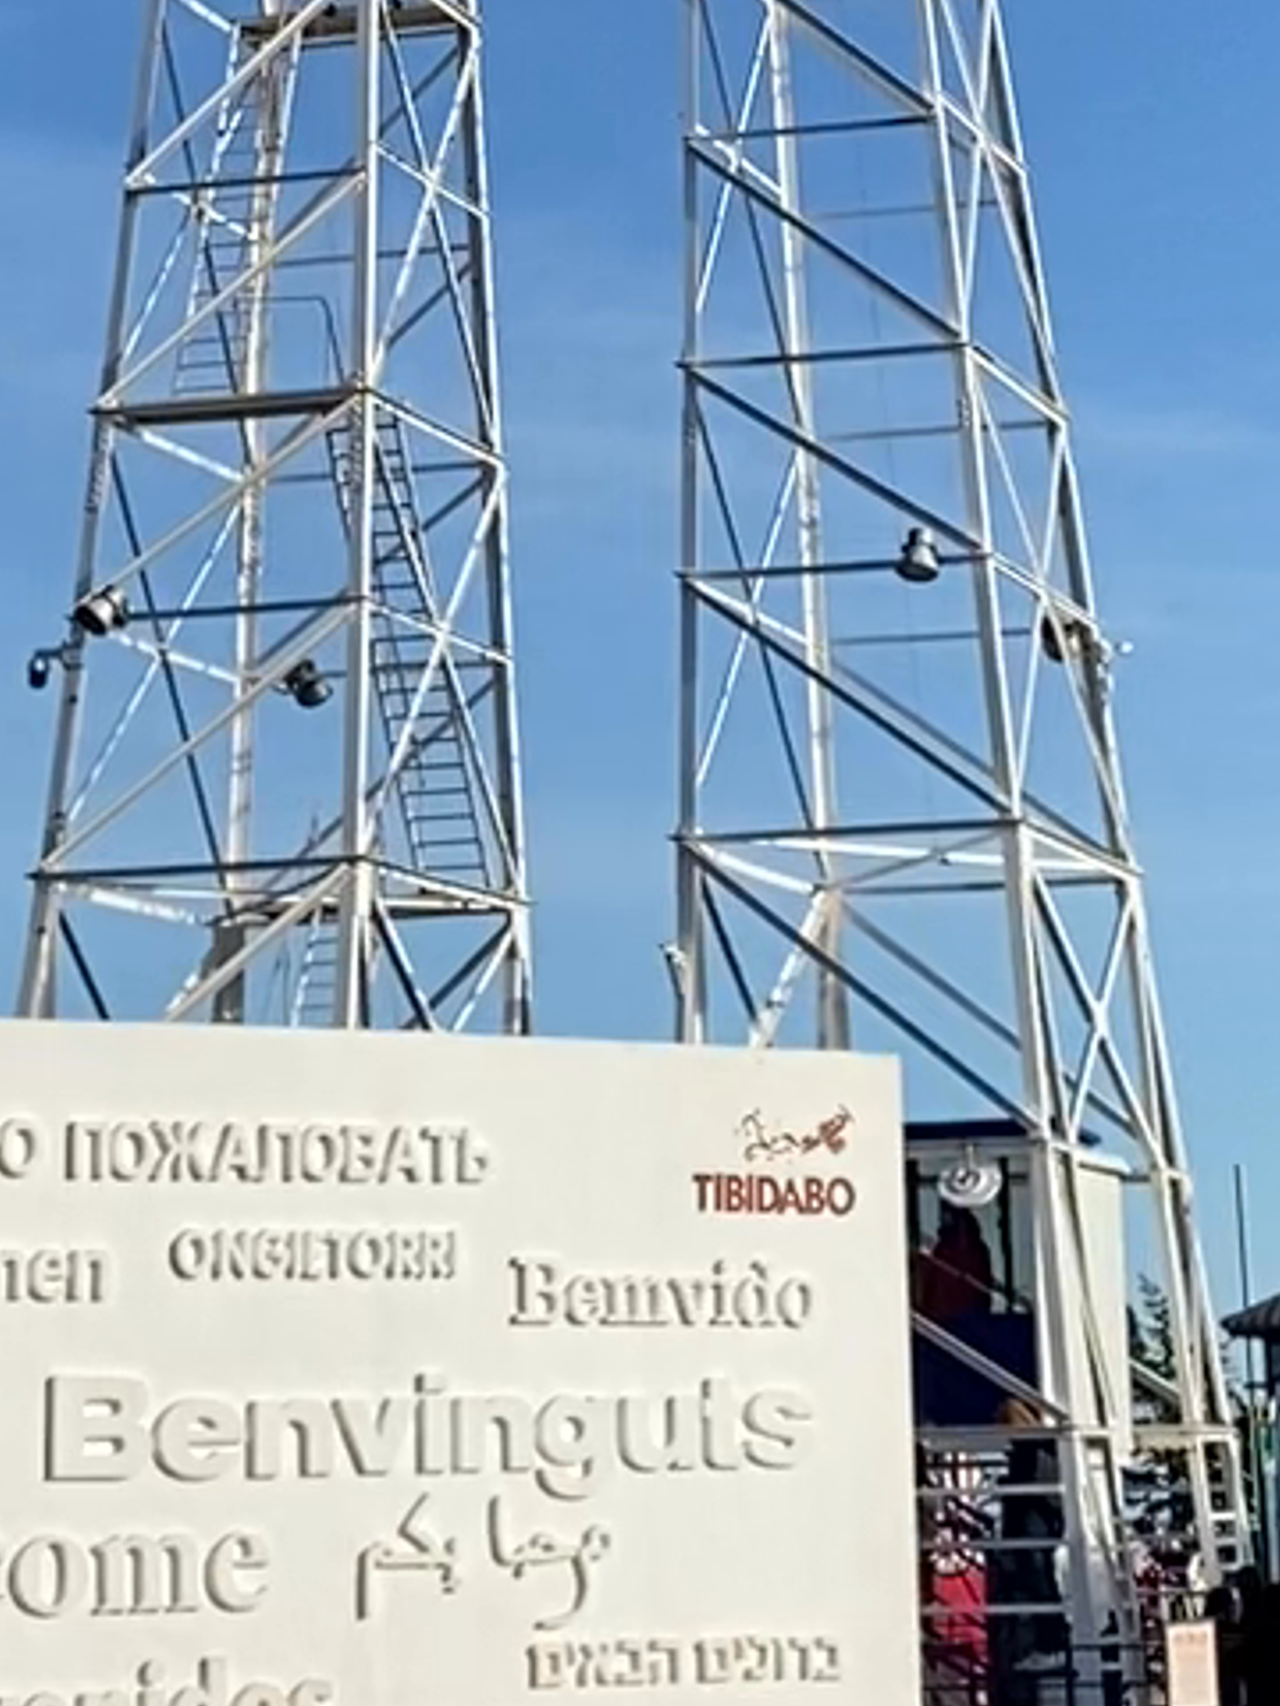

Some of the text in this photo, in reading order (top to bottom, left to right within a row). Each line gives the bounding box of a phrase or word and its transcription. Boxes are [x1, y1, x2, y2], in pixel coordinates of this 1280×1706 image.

[62, 1120, 491, 1185] ПОЖАЛОВАТЬ
[691, 1172, 856, 1216] TIBIDABO
[42, 1371, 816, 1501] Benvinguts
